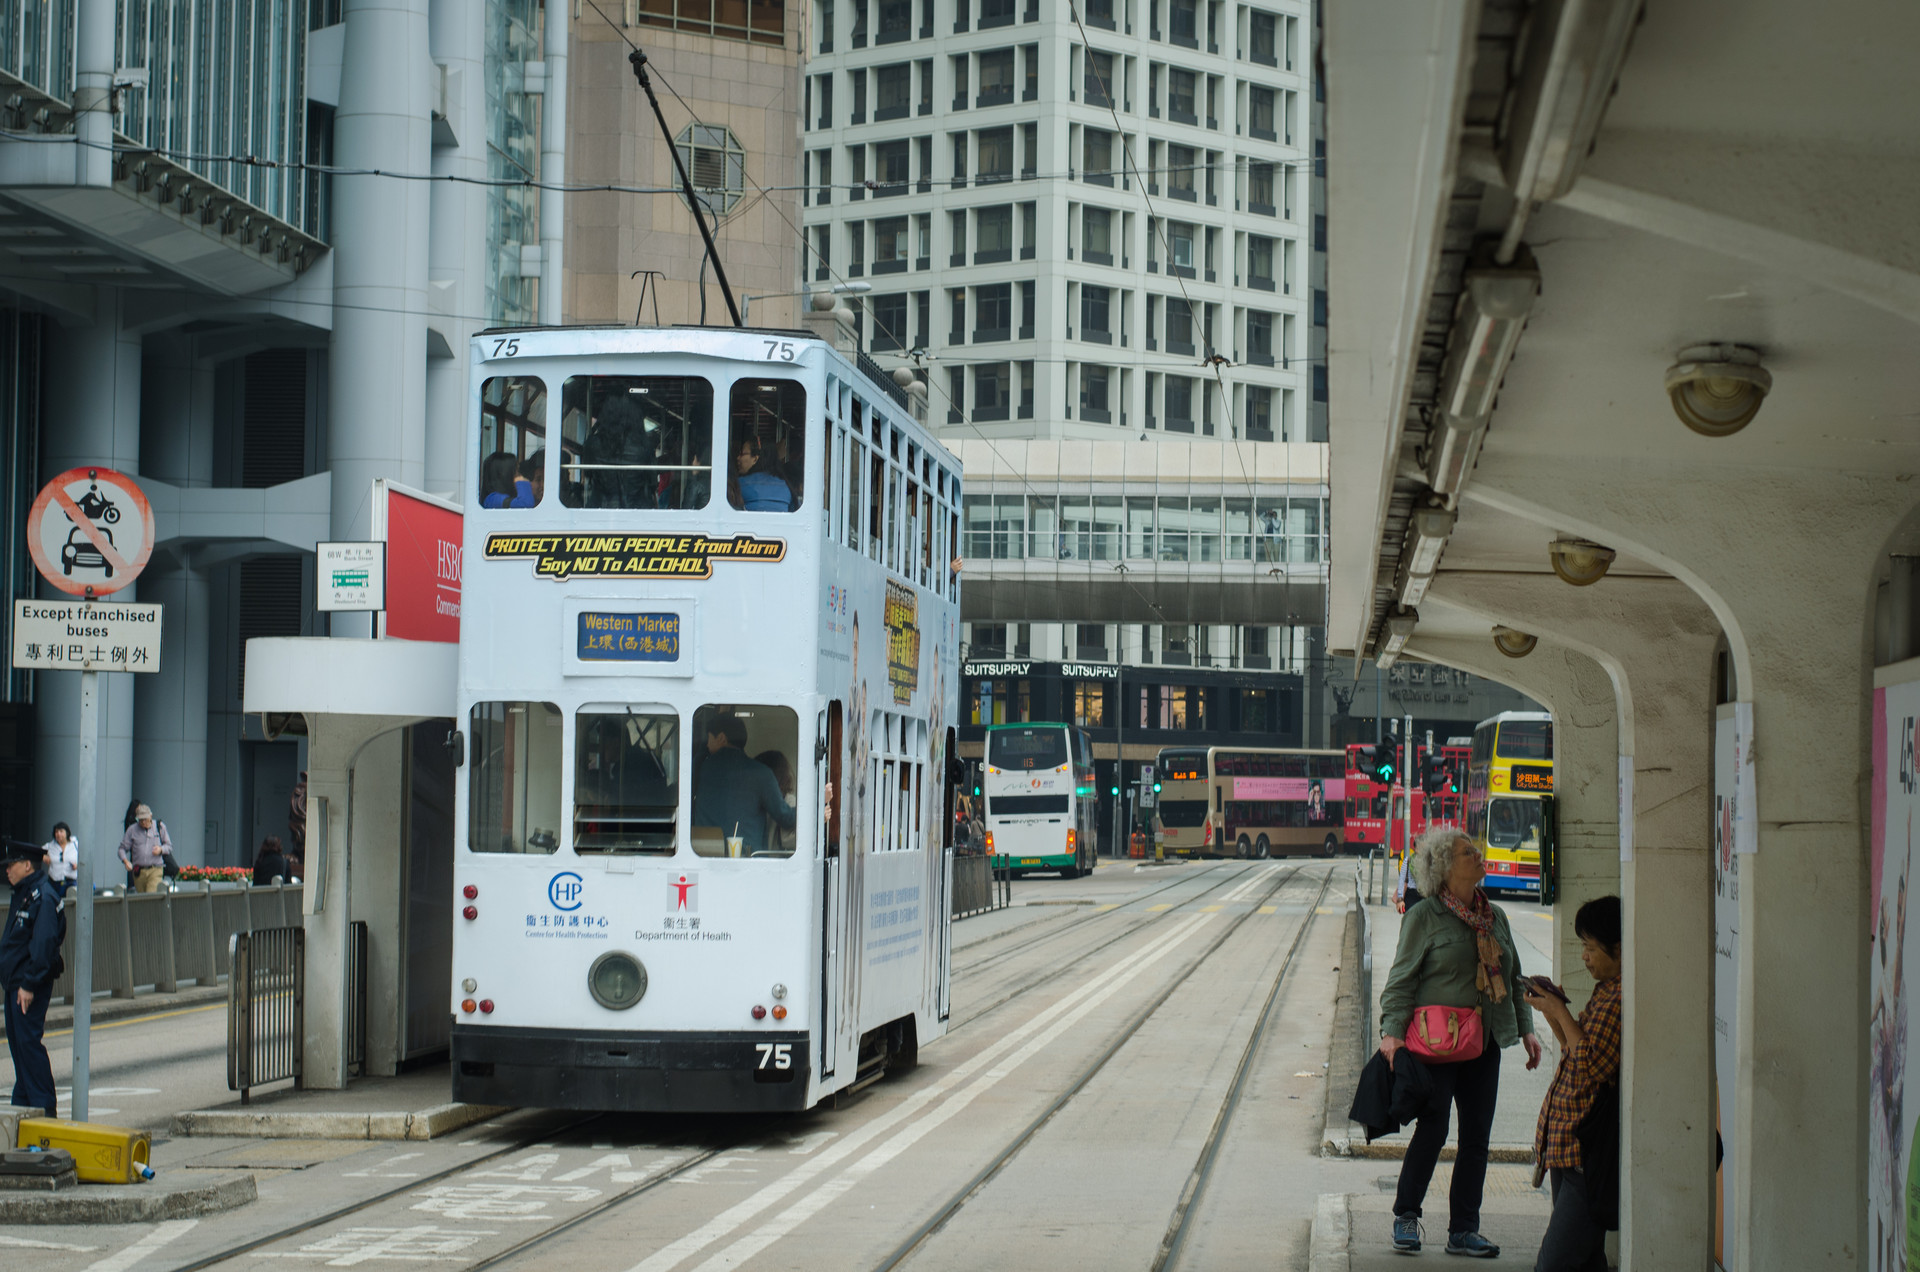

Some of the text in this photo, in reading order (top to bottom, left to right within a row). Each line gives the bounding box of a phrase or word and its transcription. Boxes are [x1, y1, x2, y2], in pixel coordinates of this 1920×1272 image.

[490, 337, 520, 358] 75
[763, 339, 796, 362] 75
[488, 536, 779, 556] PROTECT YOUNG PEOPLE from Harm
[437, 539, 464, 583] HSBC
[539, 556, 707, 574] Say NO To ALCOHOL
[22, 605, 155, 622] Except franchised
[585, 613, 679, 633] Western Market
[67, 623, 109, 637] buses
[25, 642, 149, 665] 專利巴士例外
[965, 663, 1030, 676] SUITSUPPLY
[1062, 664, 1119, 678] SUITSUPPLY
[525, 930, 608, 939] Centre for Health Protection
[635, 929, 732, 941] Department of Health
[755, 1043, 792, 1070] 75
